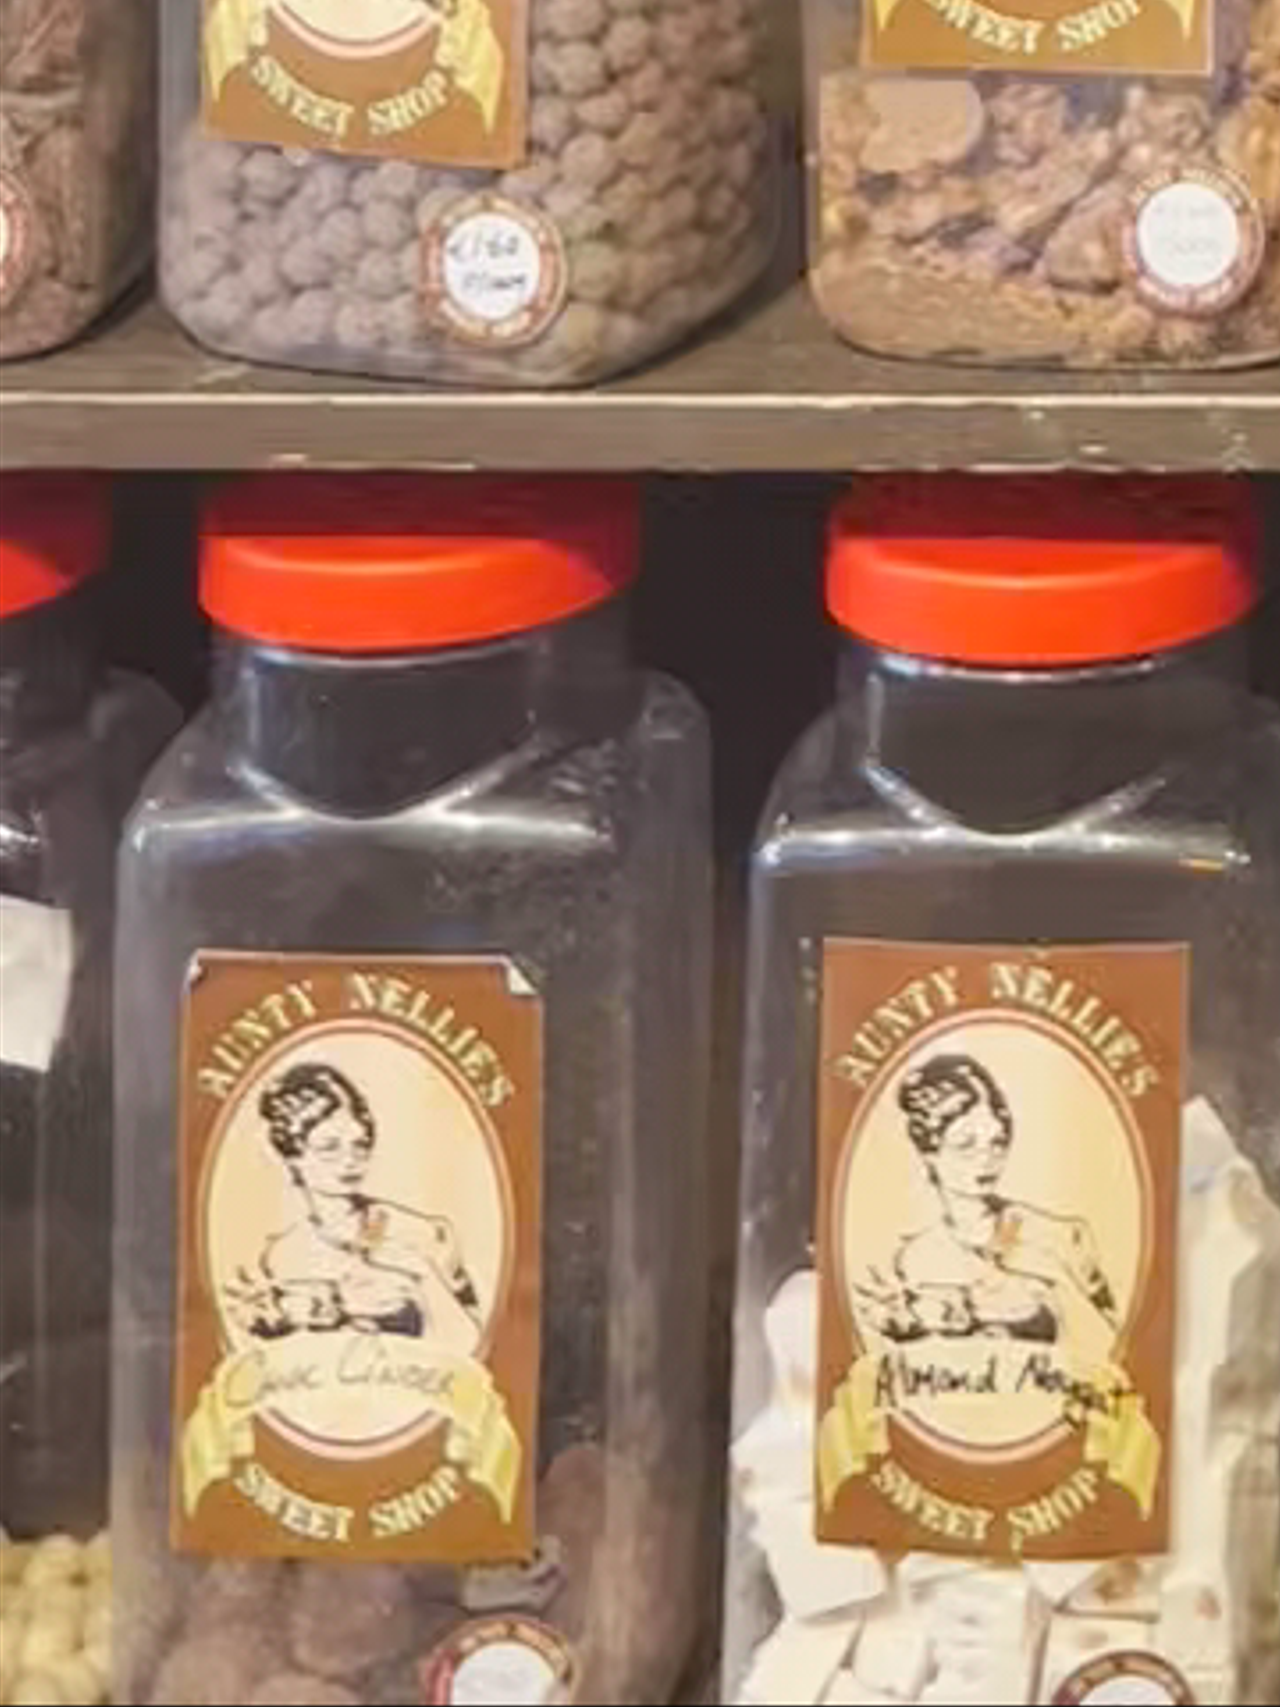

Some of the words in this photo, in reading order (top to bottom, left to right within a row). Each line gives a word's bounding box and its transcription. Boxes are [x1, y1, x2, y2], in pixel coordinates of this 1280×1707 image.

[251, 64, 350, 136] SWEET
[368, 74, 447, 136] SHOP
[202, 981, 318, 1096] AUNTY
[830, 967, 959, 1087] AUNTY
[233, 1464, 356, 1542] SWEET
[370, 1464, 460, 1539] SHOP
[870, 1464, 995, 1540] SWEET
[1008, 1467, 1099, 1539] SHOP
